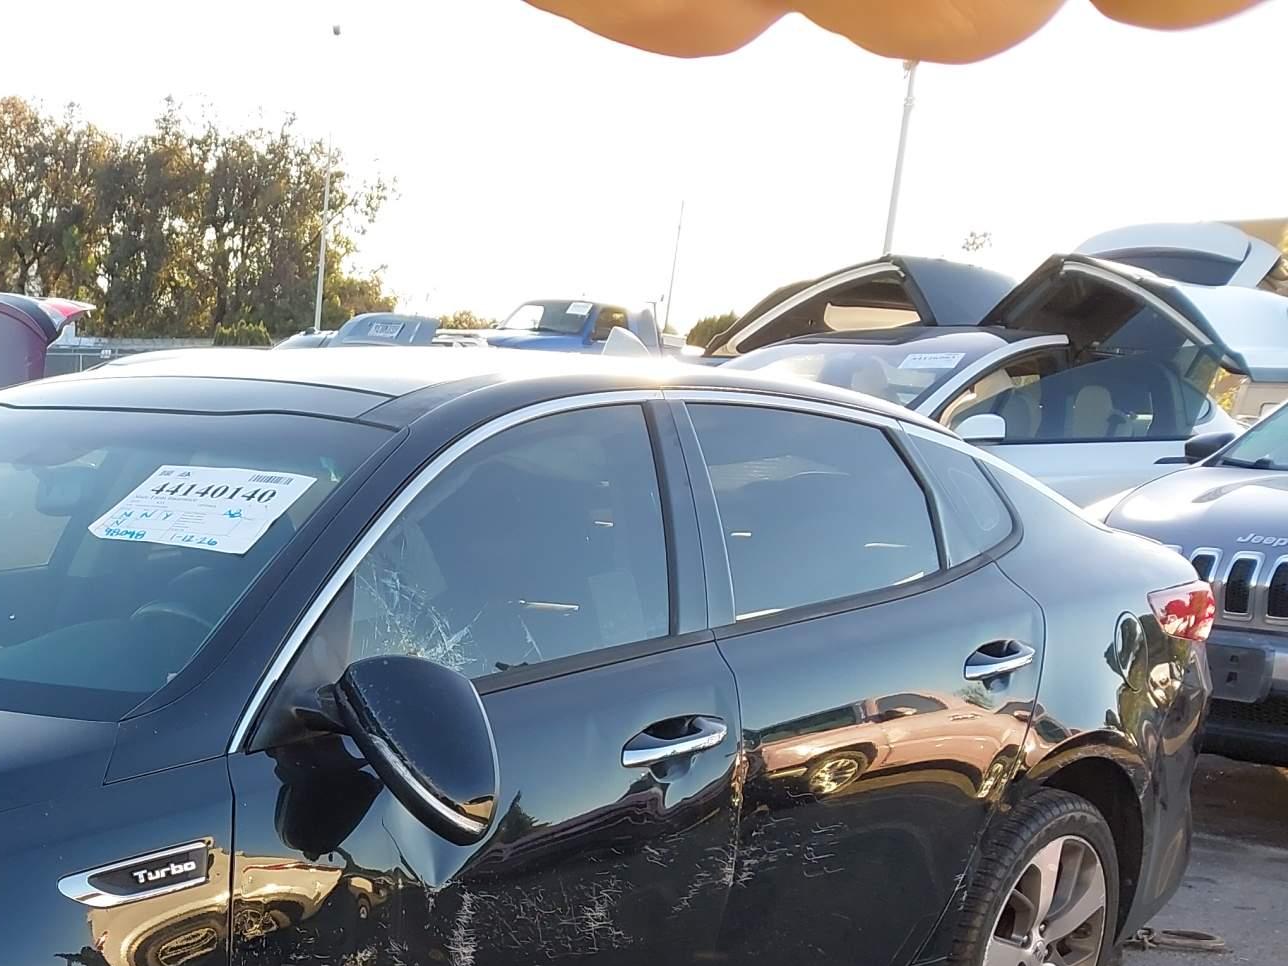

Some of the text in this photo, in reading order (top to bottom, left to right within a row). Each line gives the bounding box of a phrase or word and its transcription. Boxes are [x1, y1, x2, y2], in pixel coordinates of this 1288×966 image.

[151, 482, 276, 503] 44140140
[1236, 533, 1288, 547] Jeep
[132, 861, 197, 884] Turbo
